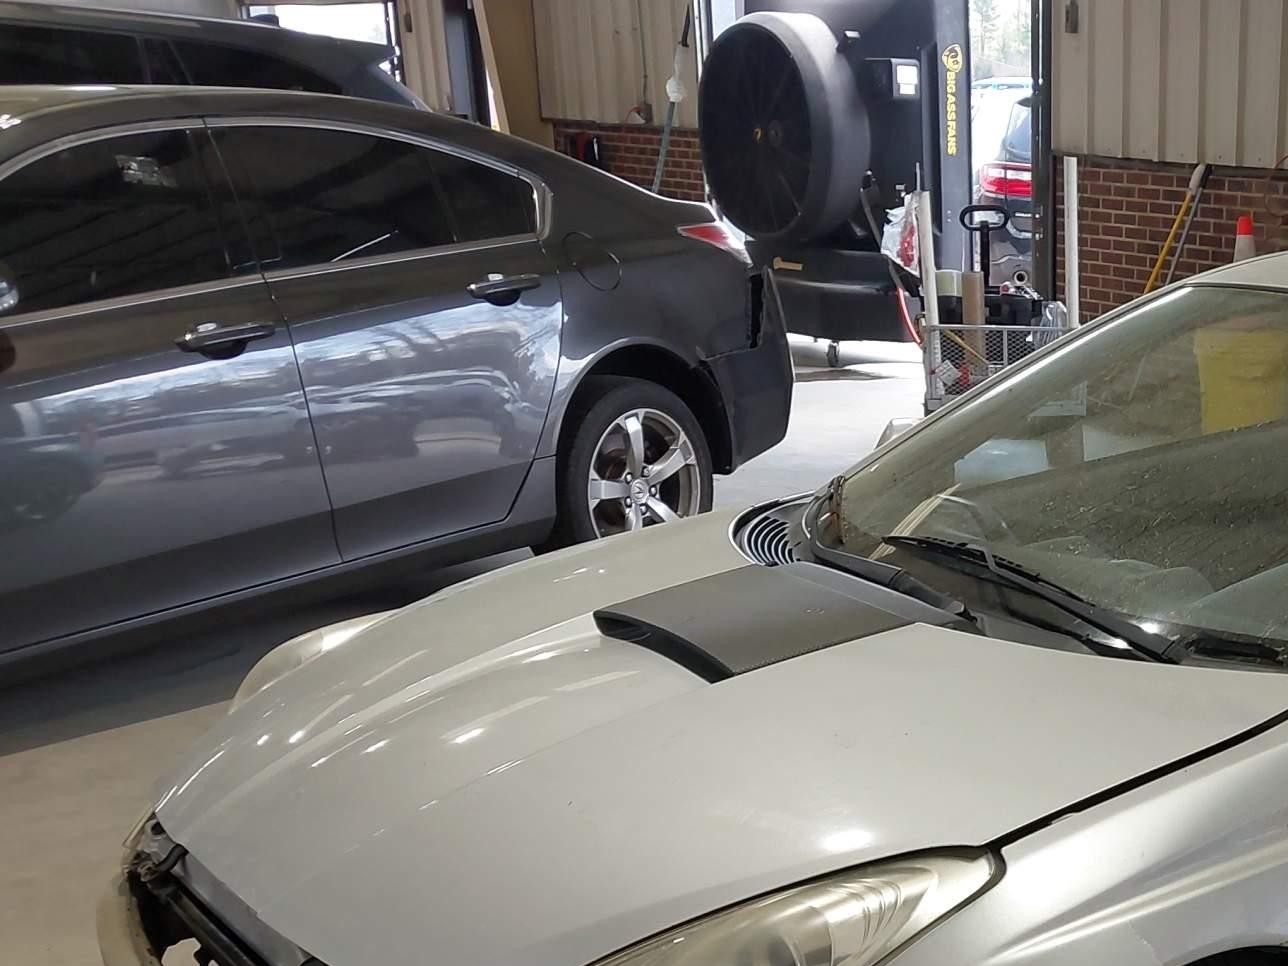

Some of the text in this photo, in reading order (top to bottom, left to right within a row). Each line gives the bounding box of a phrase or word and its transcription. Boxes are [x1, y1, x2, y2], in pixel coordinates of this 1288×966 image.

[946, 71, 957, 155] BIG ASS FANS
